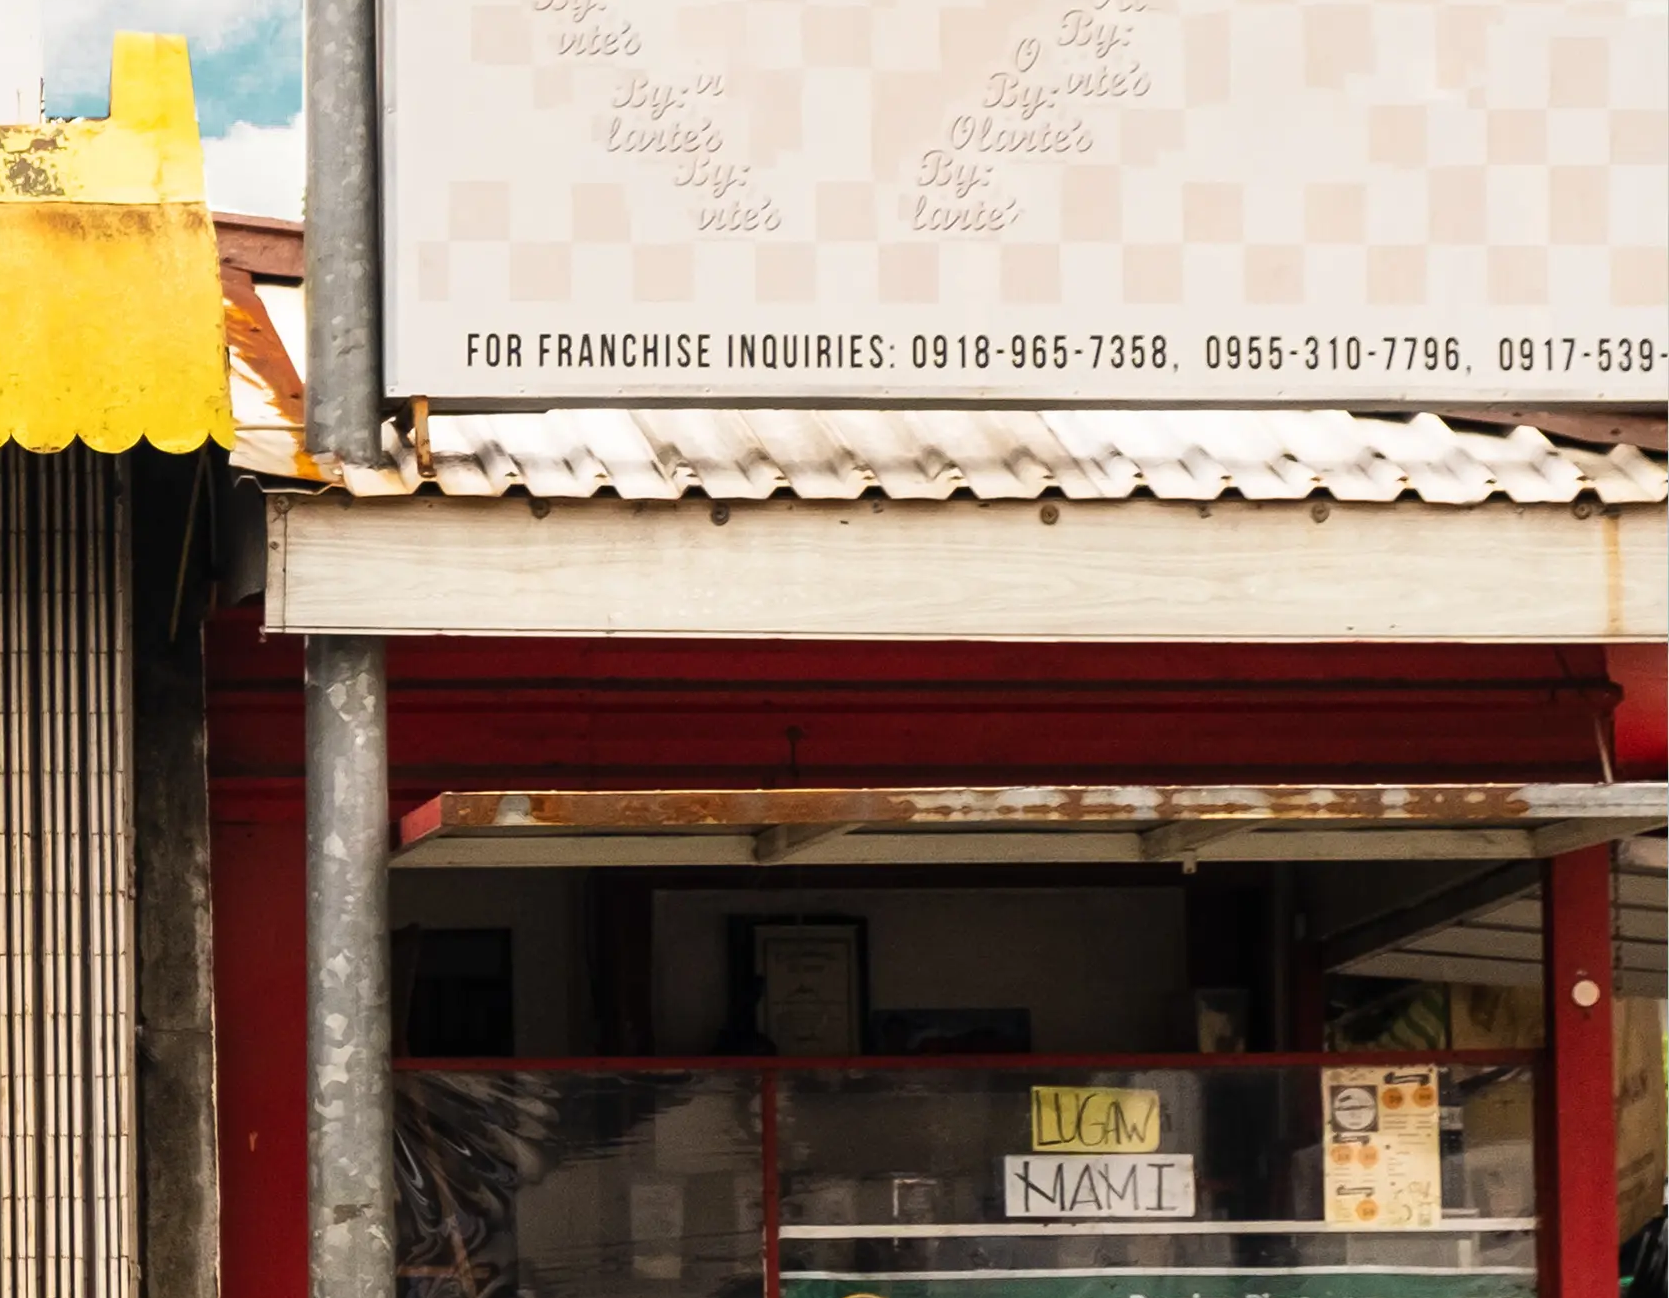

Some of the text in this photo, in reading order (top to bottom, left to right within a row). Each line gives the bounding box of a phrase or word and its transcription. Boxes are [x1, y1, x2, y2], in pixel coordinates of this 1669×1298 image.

[467, 333, 1668, 374] FOR FRANCHISE INQUIRIES: 0918-965-7358, 0955-310-7796, 0917-539-
[1034, 1089, 1157, 1147] LUGAW
